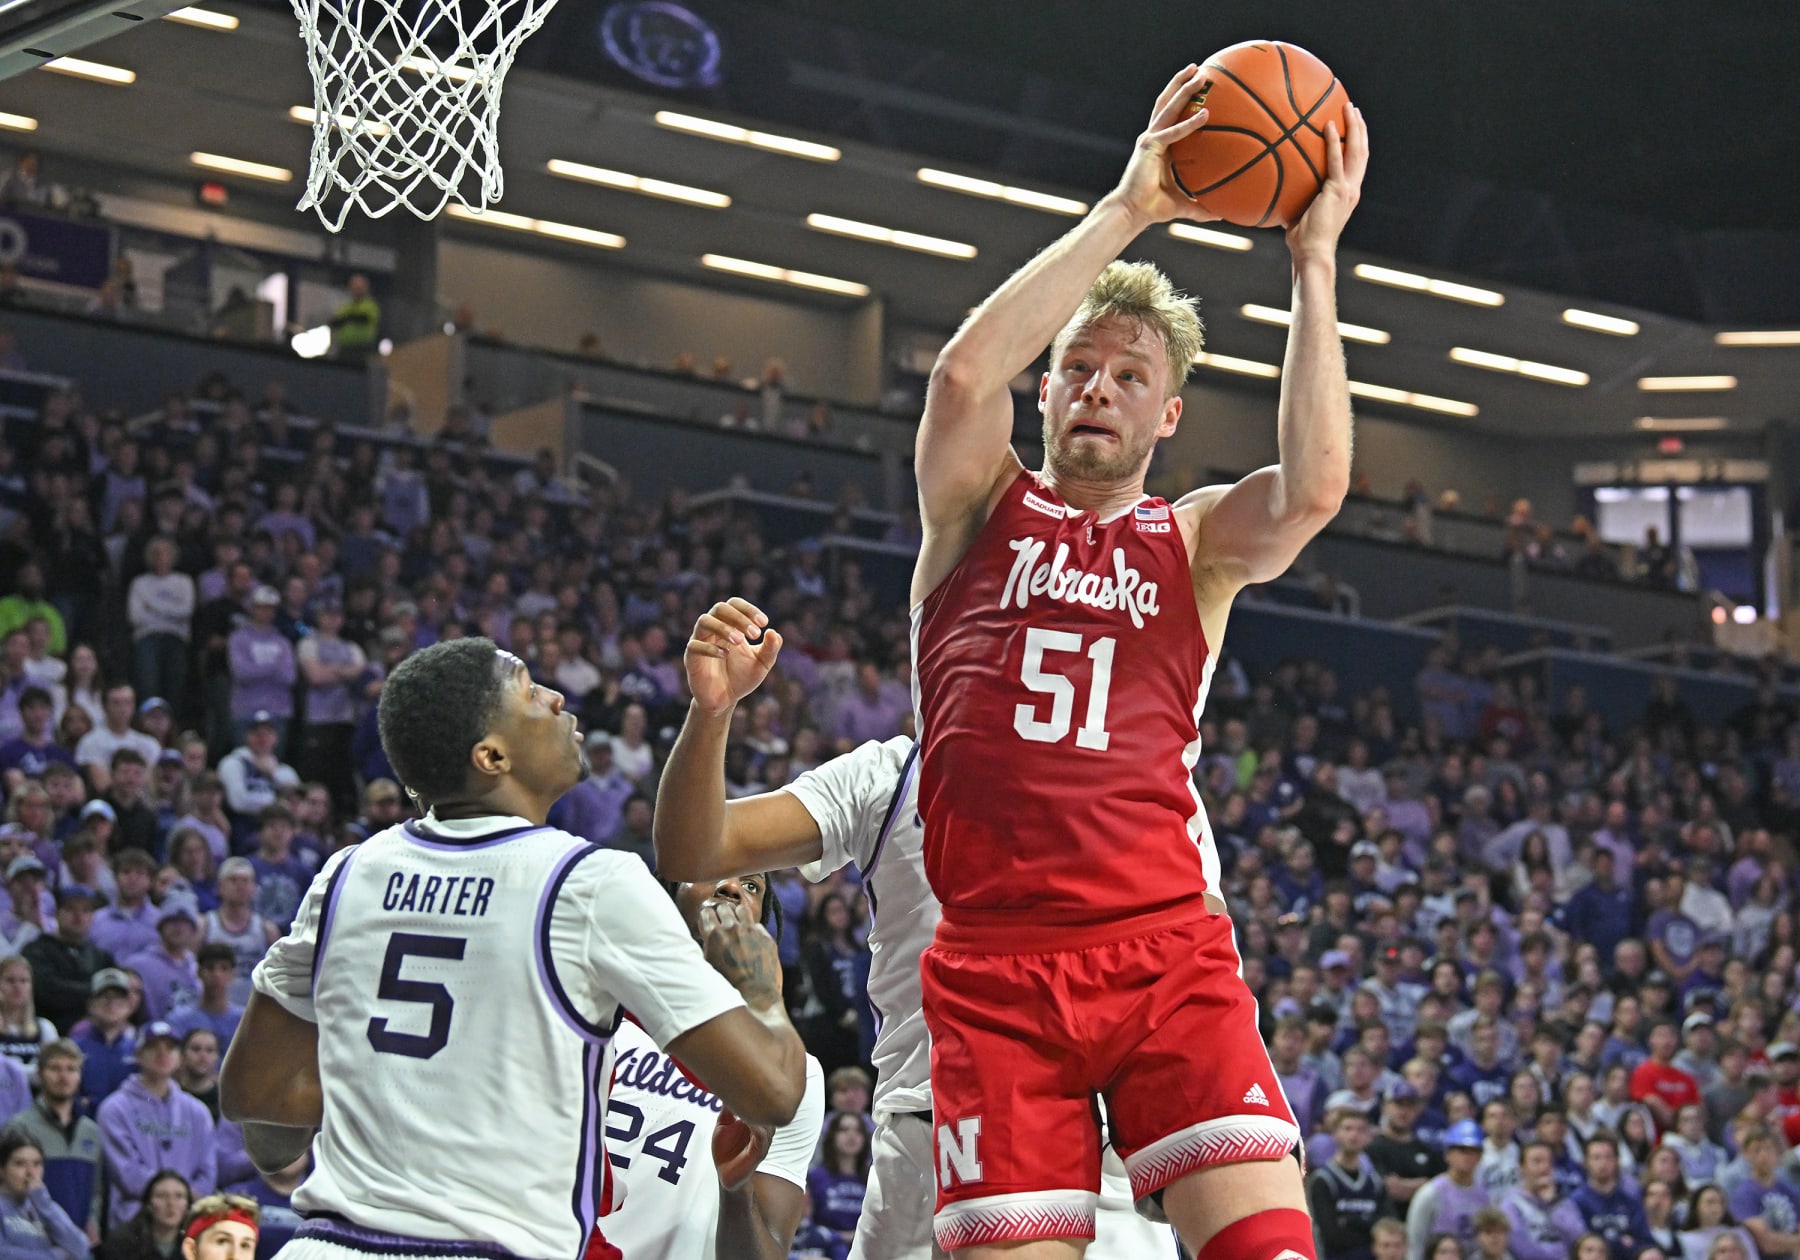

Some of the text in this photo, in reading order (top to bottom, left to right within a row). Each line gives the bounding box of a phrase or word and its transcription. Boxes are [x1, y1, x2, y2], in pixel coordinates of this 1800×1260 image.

[1026, 496, 1063, 516] GRADUATE
[999, 536, 1161, 629] Nebraska
[1013, 627, 1117, 752] 51
[382, 872, 495, 917] CARTER
[366, 932, 468, 1060] 5
[605, 1098, 696, 1186] 24
[938, 1115, 984, 1190] N
